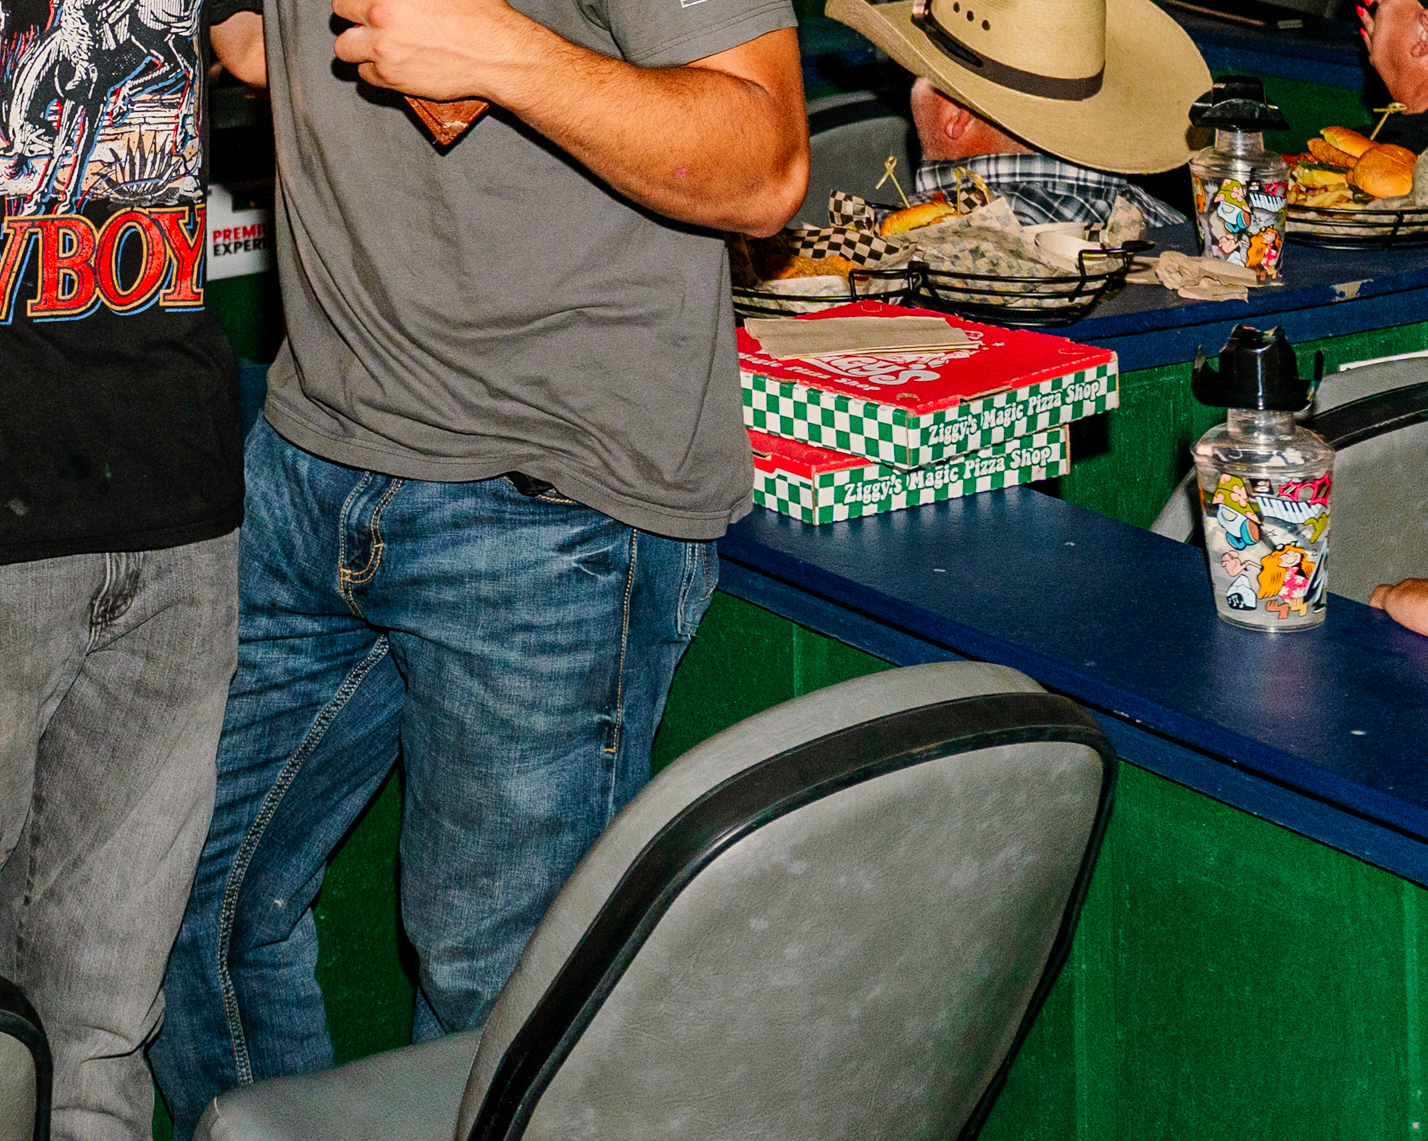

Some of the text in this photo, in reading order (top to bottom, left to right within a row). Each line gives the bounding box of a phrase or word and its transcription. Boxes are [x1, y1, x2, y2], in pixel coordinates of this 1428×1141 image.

[784, 366, 832, 380] Pizza
[834, 377, 881, 391] Shop
[928, 381, 1101, 445] Ziggy's Magic Pizza Shop
[843, 447, 1052, 505] Ziggy's Magic Pizza Shop
